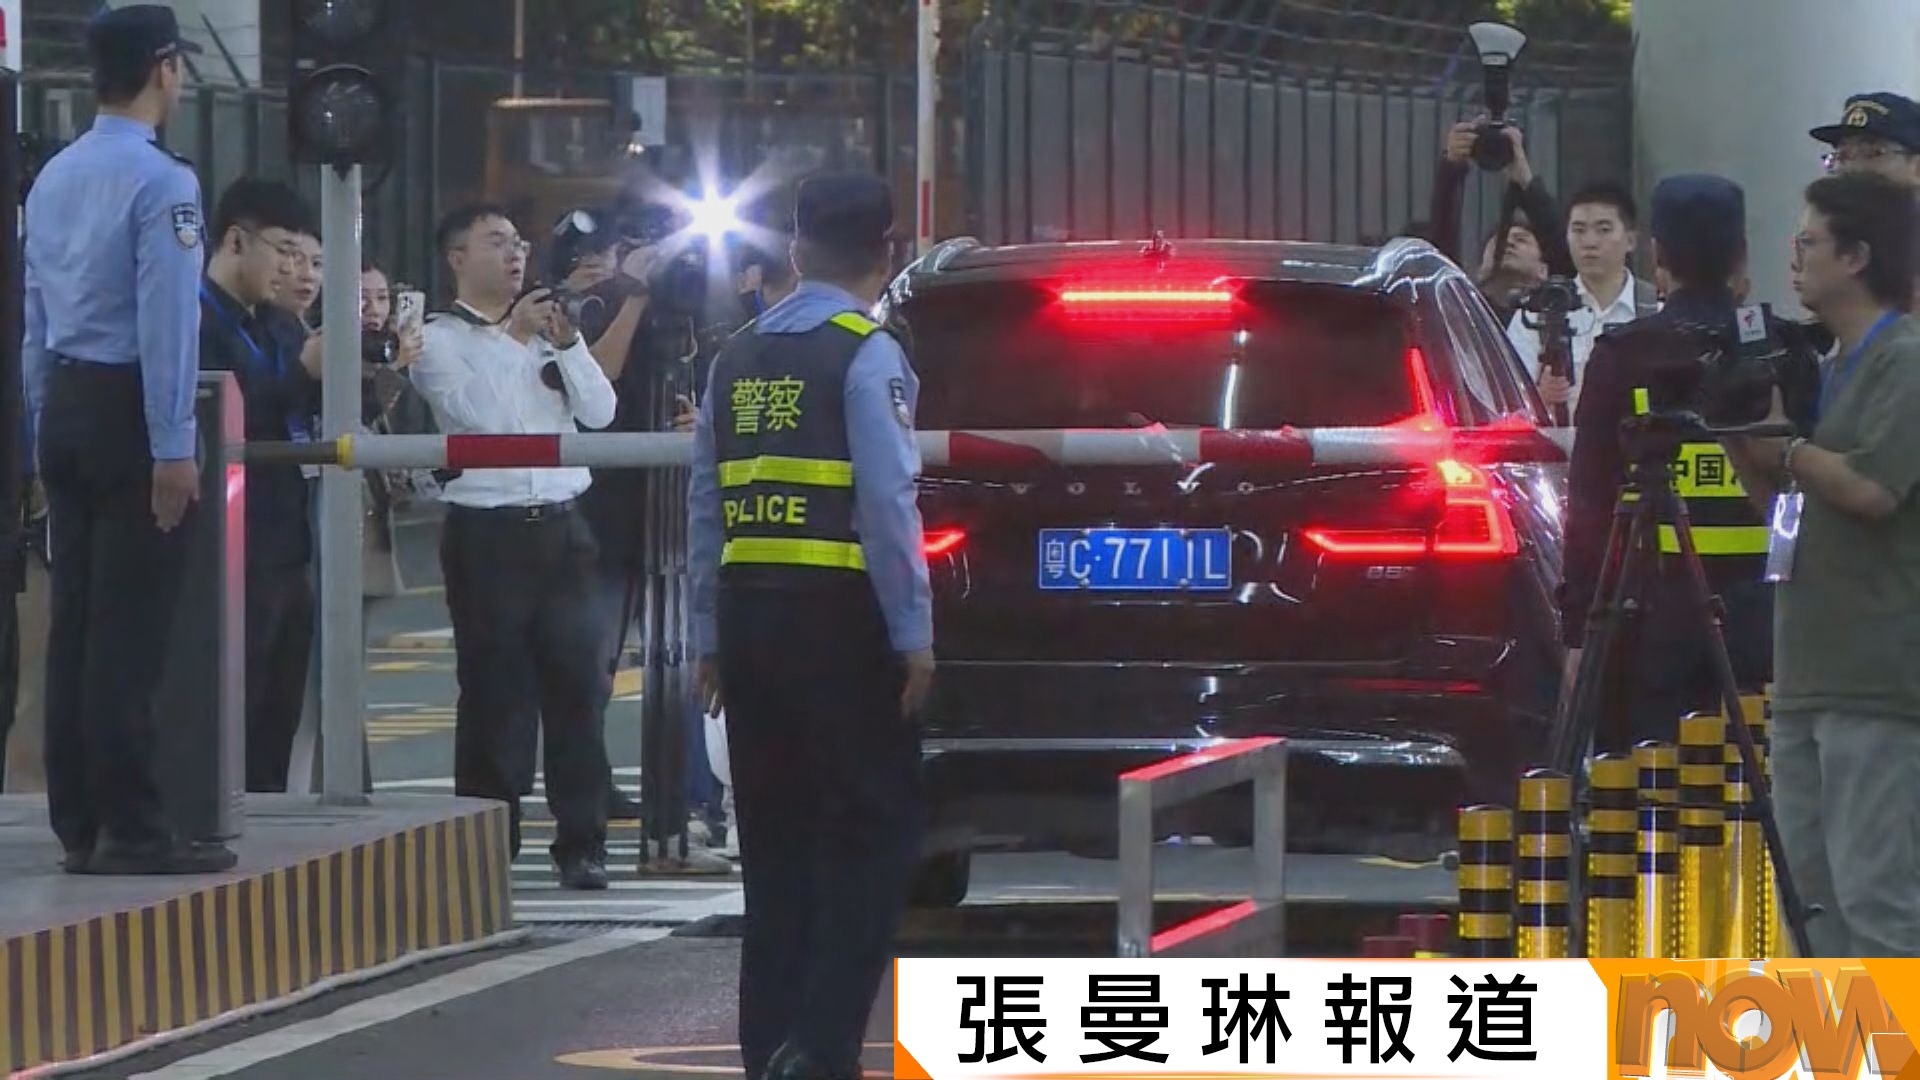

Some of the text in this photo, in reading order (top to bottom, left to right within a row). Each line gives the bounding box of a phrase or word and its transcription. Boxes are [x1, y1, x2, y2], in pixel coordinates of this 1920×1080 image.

[731, 375, 805, 434] 警察
[1008, 480, 1255, 495] VOLVO
[1672, 453, 1737, 494] 中国
